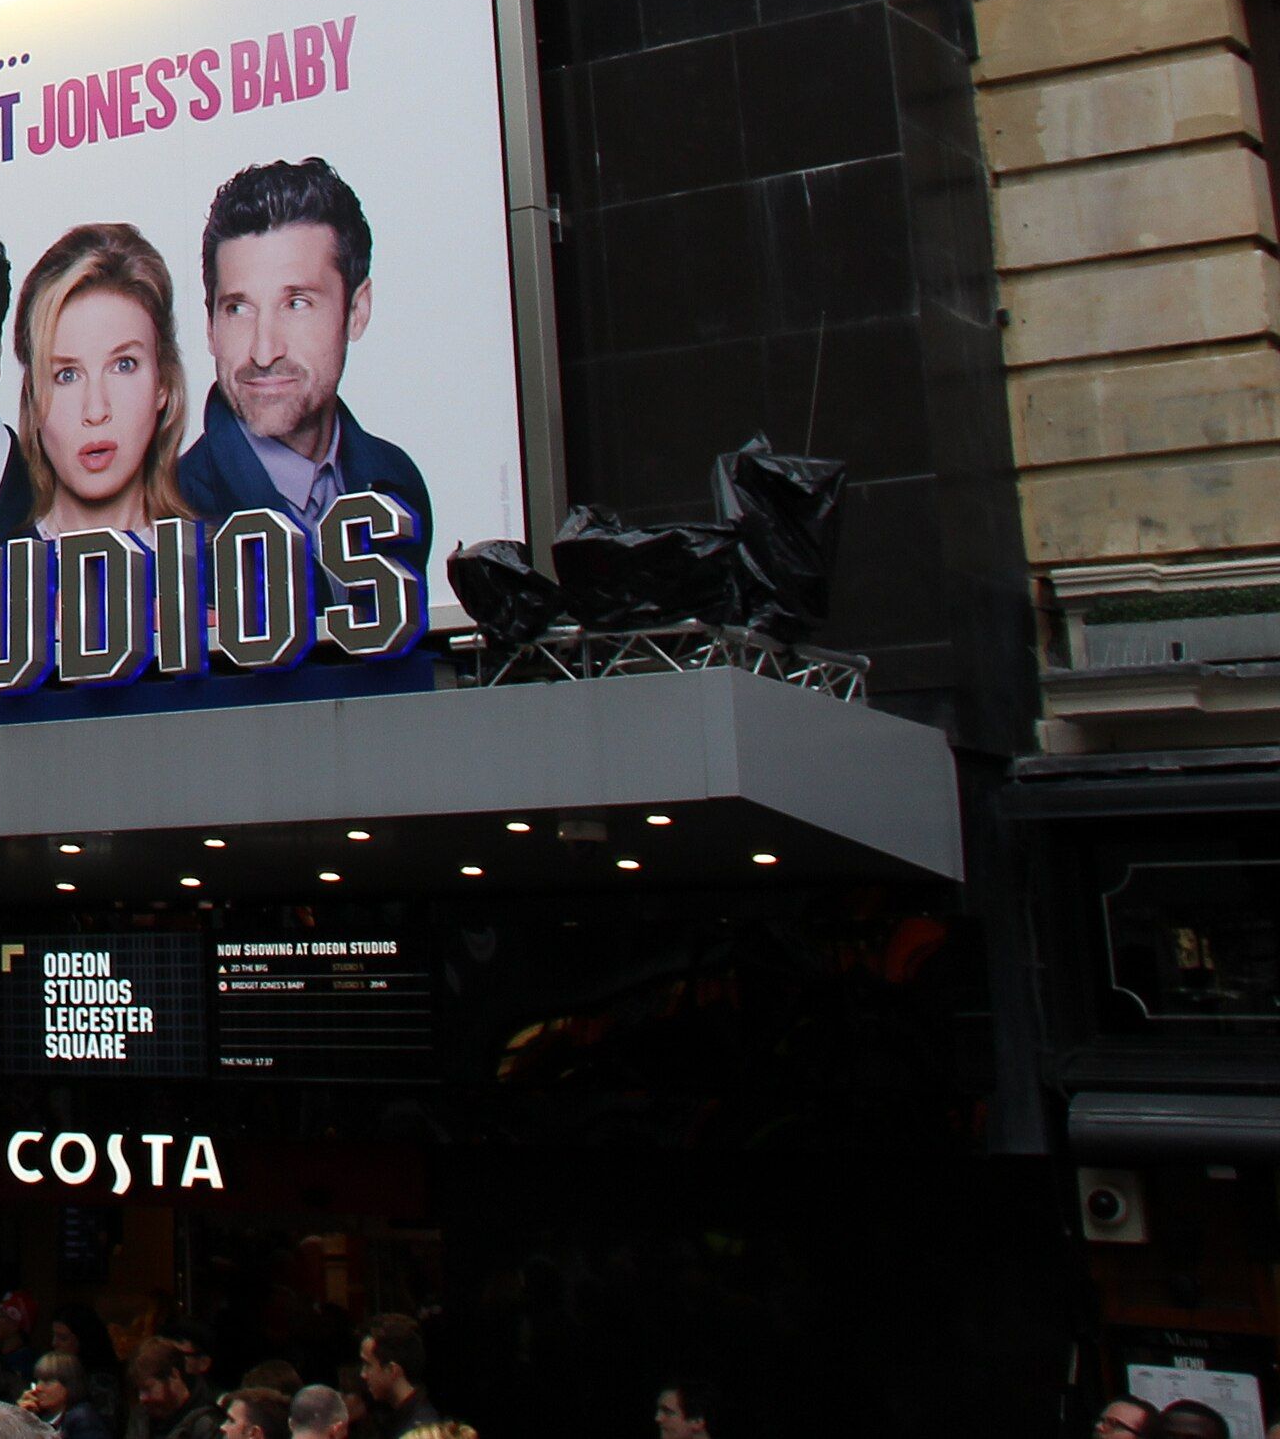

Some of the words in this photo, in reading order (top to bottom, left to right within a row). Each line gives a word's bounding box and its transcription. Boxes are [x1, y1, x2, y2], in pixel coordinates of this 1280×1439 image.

[26, 47, 223, 156] JONES'S
[230, 14, 357, 115] BABY
[216, 943, 242, 957] NOW
[243, 942, 294, 956] SHOWING
[295, 942, 309, 956] AT
[311, 942, 348, 956] ODEON
[349, 940, 398, 955] STUDIOS
[43, 951, 111, 979] ODEON
[43, 978, 133, 1005] STUDIOS
[44, 1006, 154, 1034] LEICESTER
[44, 1032, 127, 1061] SQUARE
[6, 1130, 224, 1195] COSTA
